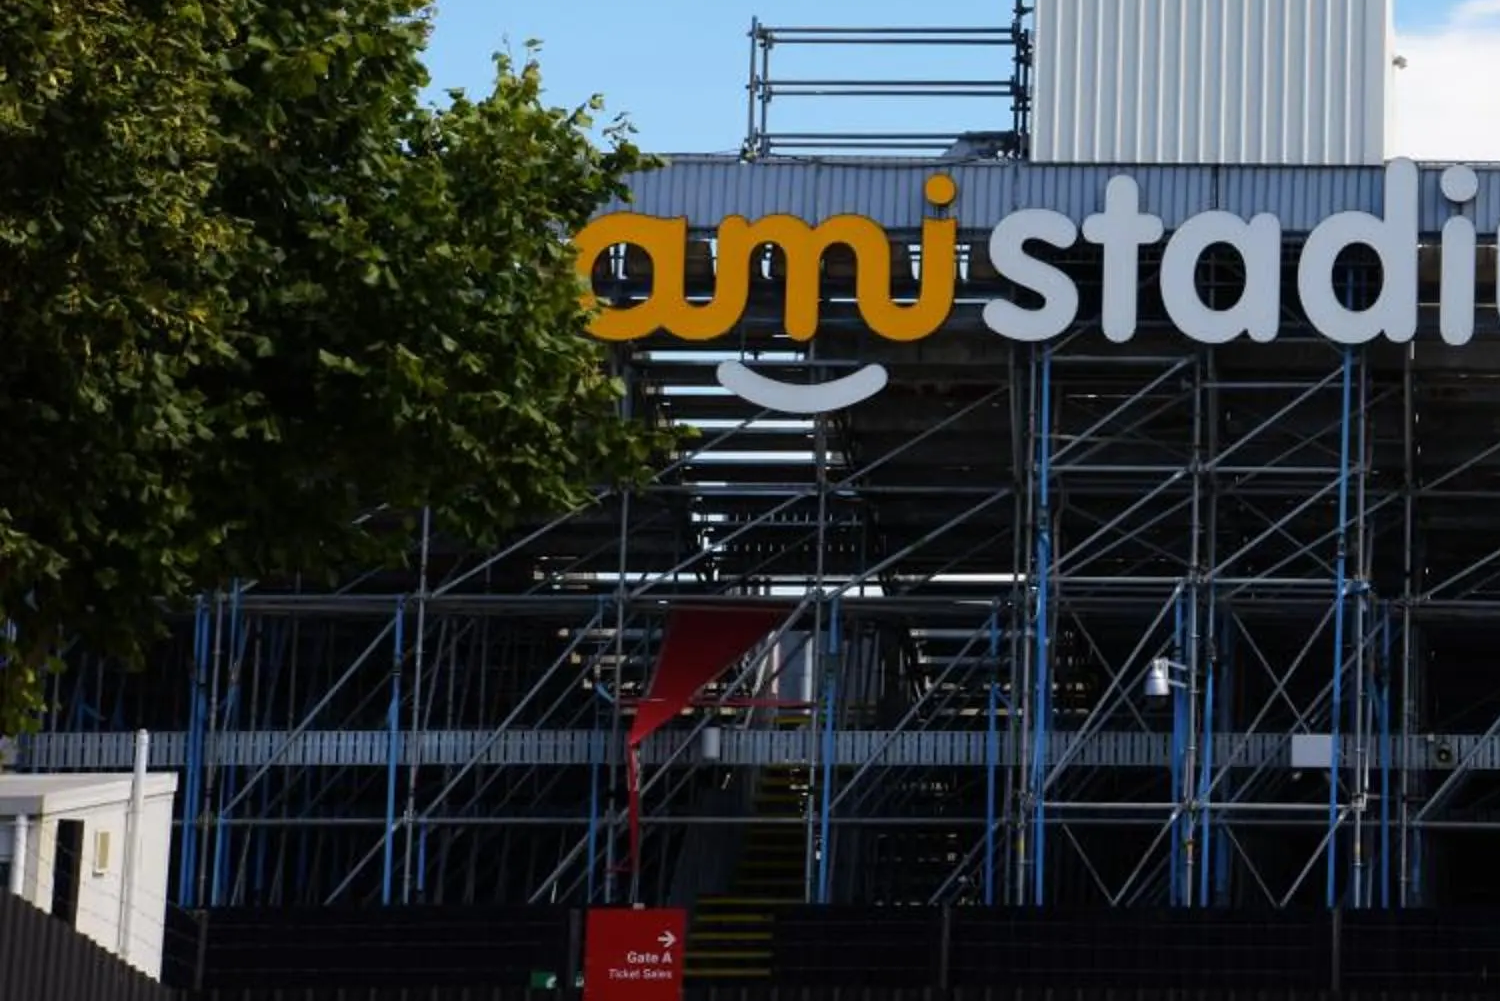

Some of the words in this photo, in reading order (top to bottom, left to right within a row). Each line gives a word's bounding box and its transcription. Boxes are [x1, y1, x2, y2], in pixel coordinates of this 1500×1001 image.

[575, 174, 957, 341] ami
[627, 951, 659, 964] Gate
[661, 951, 673, 964] A
[608, 968, 641, 979] Ticket
[643, 968, 673, 979] Sales
